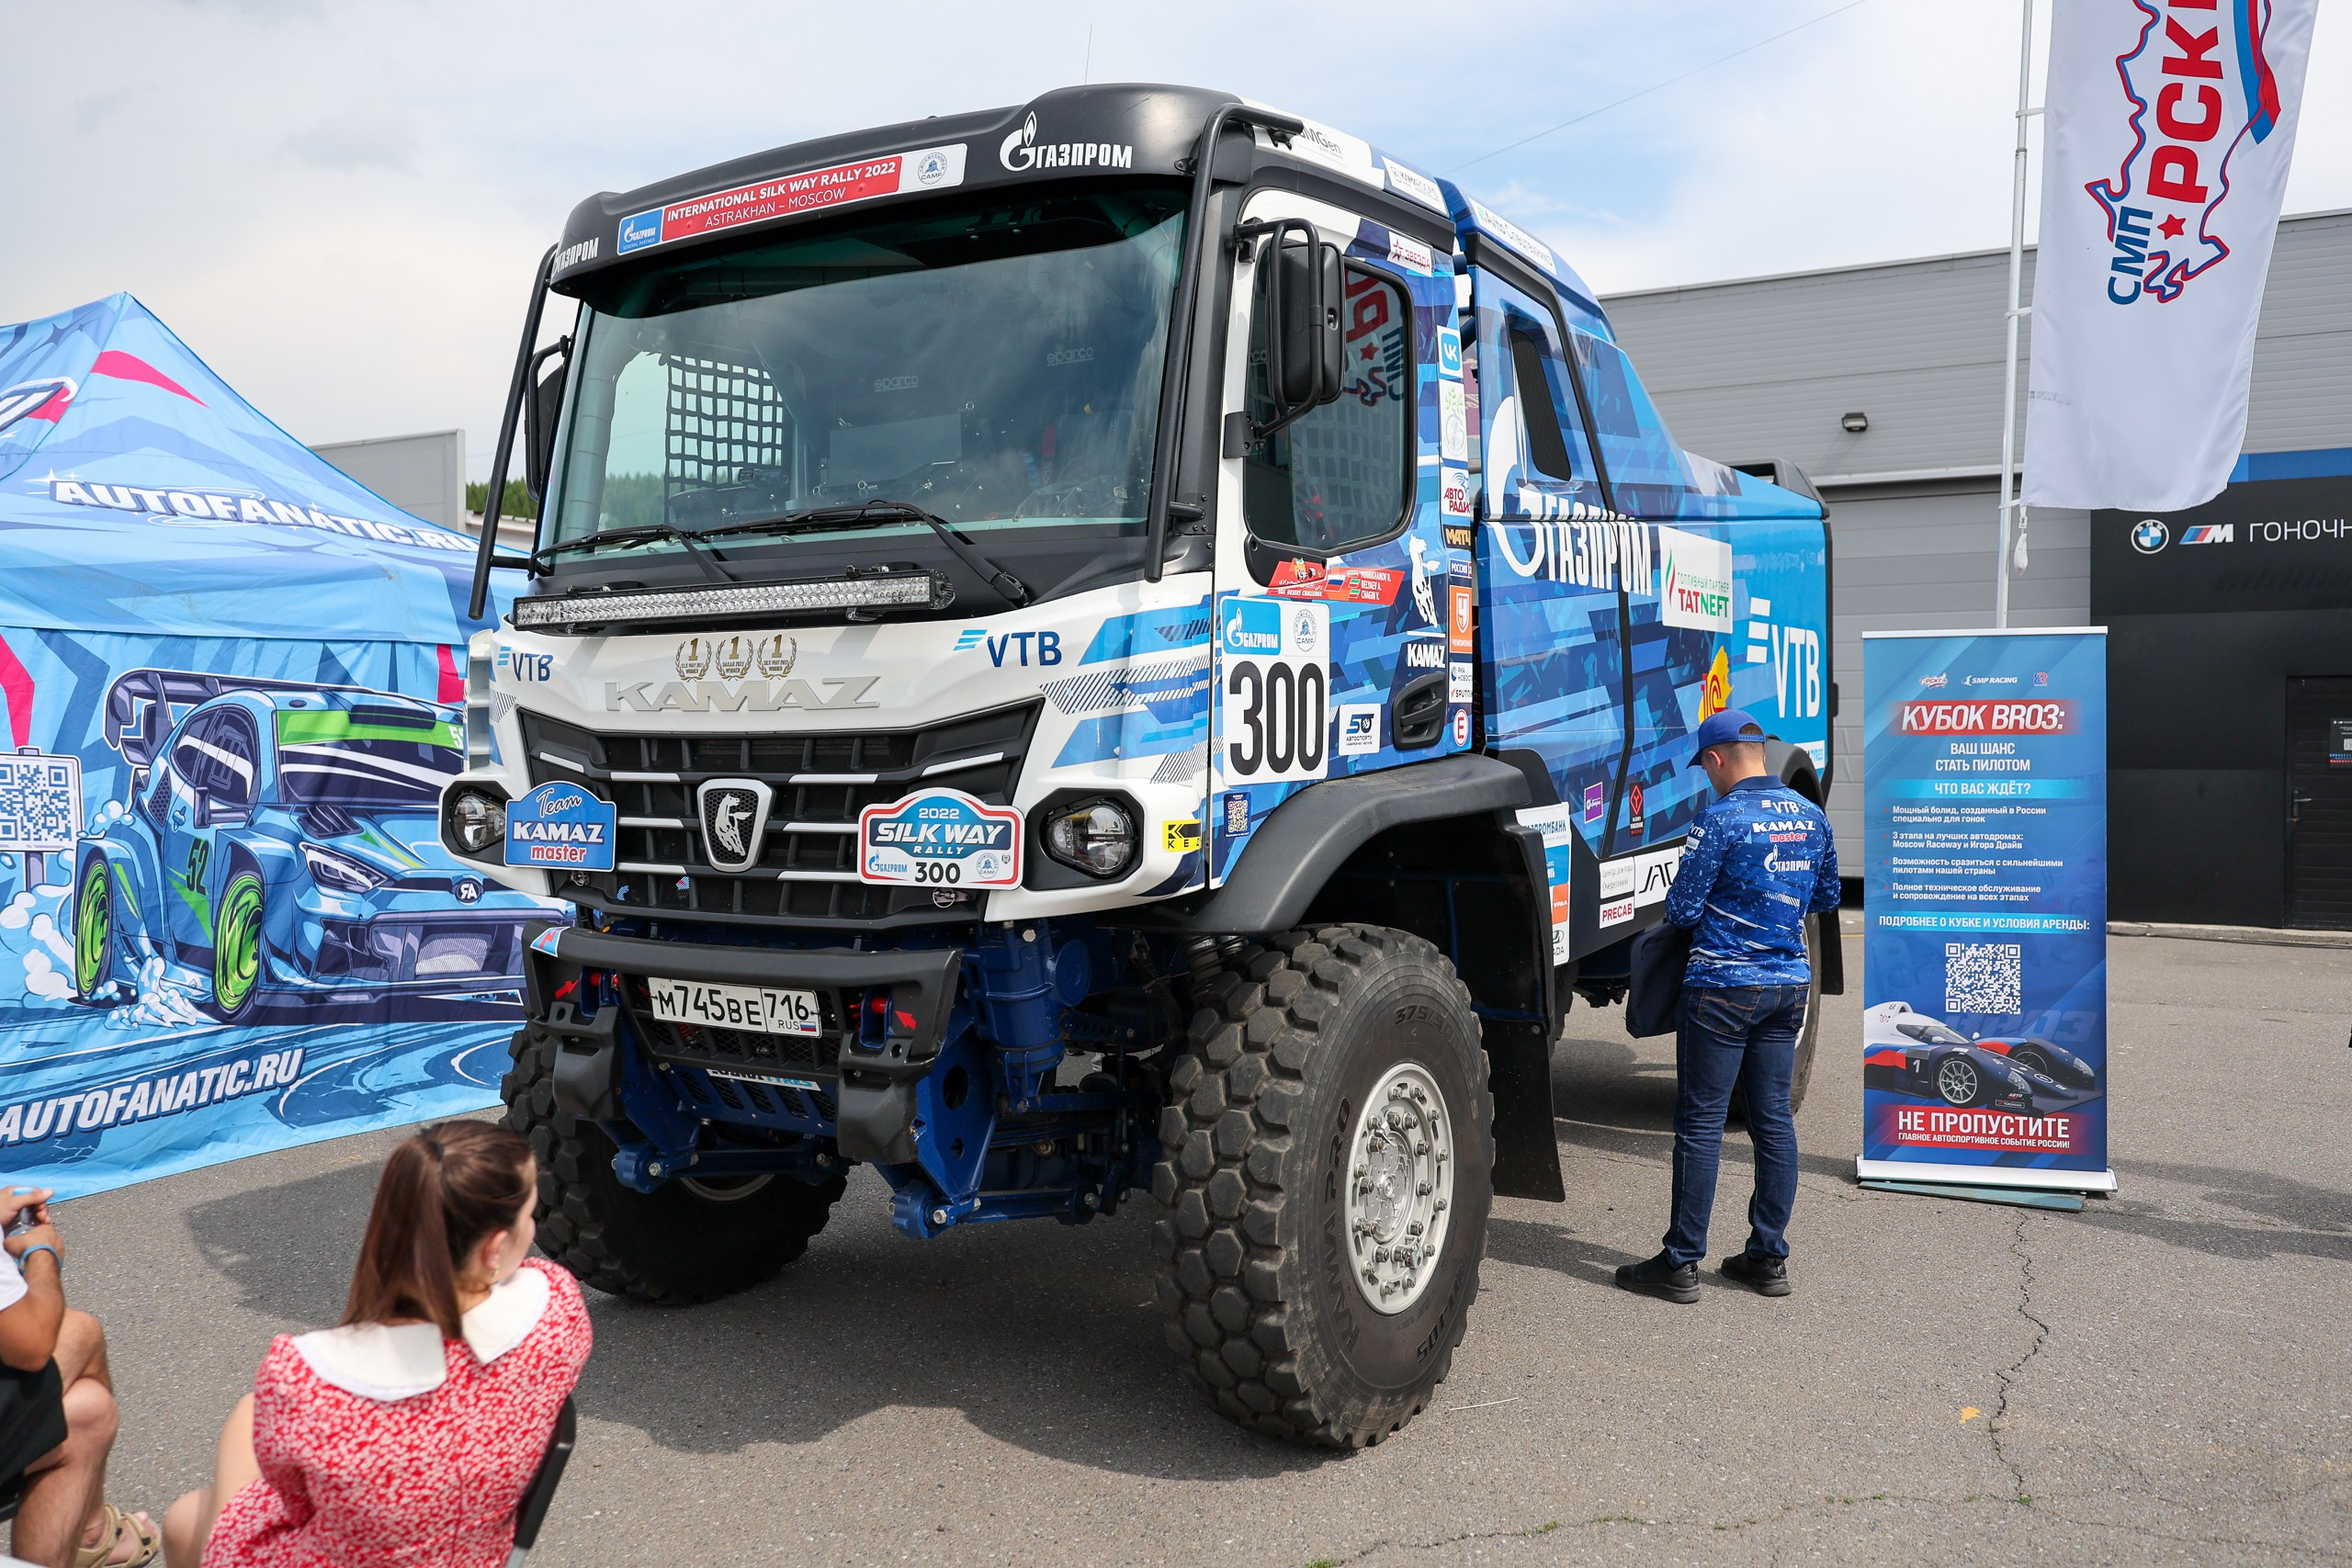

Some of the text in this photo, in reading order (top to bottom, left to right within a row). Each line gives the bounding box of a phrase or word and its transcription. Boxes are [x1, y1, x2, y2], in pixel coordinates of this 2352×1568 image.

[1035, 142, 1133, 169] ГАЗПРОМ
[667, 161, 897, 222] INTERNATIONAL SILK WAY RALLY 2022
[705, 187, 846, 229] ASTRAKHAN MOSCOW
[557, 237, 600, 273] ГАЗПРОМ
[2108, 206, 2154, 305] СМП
[1443, 488, 1464, 501] АВТО
[53, 479, 480, 552] AUTOFANATIC.RU
[1544, 493, 1653, 597] ГАЗПРОМ
[1451, 563, 1468, 575] РОССИЯ
[1678, 588, 1729, 618] TATNEFT
[688, 637, 699, 661] 1
[729, 636, 740, 660] 1
[771, 634, 783, 658] 1
[987, 631, 1062, 668] VTB
[1243, 632, 1278, 649] GAZPROM
[1407, 643, 1446, 669] KAMAZ
[513, 653, 554, 682] VTB
[1771, 624, 1821, 718] VTB
[1989, 676, 2018, 684] RACING
[605, 675, 881, 712] KAMAZ
[1228, 660, 1324, 776] 300
[1457, 716, 1464, 739] E
[1902, 705, 1988, 731] КУБОК
[1951, 743, 2016, 755] ВАШ ШАНС
[1935, 759, 2030, 772] СТАТЬ ПИЛОТОМ
[1935, 780, 2031, 796] ЧТО ВАС ЖДЁТ?
[537, 788, 582, 818] Team
[919, 807, 960, 819] 2022
[1772, 801, 1800, 814] VTB
[1894, 807, 1928, 815] Мощный
[1931, 807, 1959, 816] болид,
[1961, 807, 2007, 816] созданный
[513, 821, 605, 844] KAMAZ
[876, 823, 1006, 845] SILK WAY
[1751, 820, 1815, 833] KAMAZ
[1770, 832, 1807, 842] master
[1970, 833, 2023, 841] автодромах:
[531, 844, 586, 862] master
[912, 845, 965, 855] RALLY
[1893, 840, 1925, 849] Moscow
[1927, 841, 1962, 850] Raceway
[1971, 841, 1994, 850] Игора
[1996, 841, 2022, 850] Драйв
[187, 838, 209, 896] 52
[879, 863, 908, 874] GAZPROM
[914, 862, 961, 885] 300
[2003, 859, 2064, 867] сильнейшими
[1893, 883, 1923, 891] Полное
[1979, 885, 2041, 893] обслуживание
[1602, 903, 1633, 922] PRECAB
[1879, 916, 2090, 931] ПОДРОБНЕЕ О КУБКЕ И УСЛОВИЯ АРЕНДЫ:
[1554, 946, 1565, 955] ADA
[763, 993, 810, 1021] 716
[777, 1020, 799, 1031] RUS
[1912, 1059, 1920, 1074] 1
[0, 1047, 306, 1143] AUTOFANATIC.RU
[1898, 1111, 2070, 1138] НЕ ПРОПУСТИТЕ
[1898, 1133, 2070, 1148] ГЛАВНОЕ АВТОСПОРТИВНОЕ СОБЫТИЕ РОССИИ!
